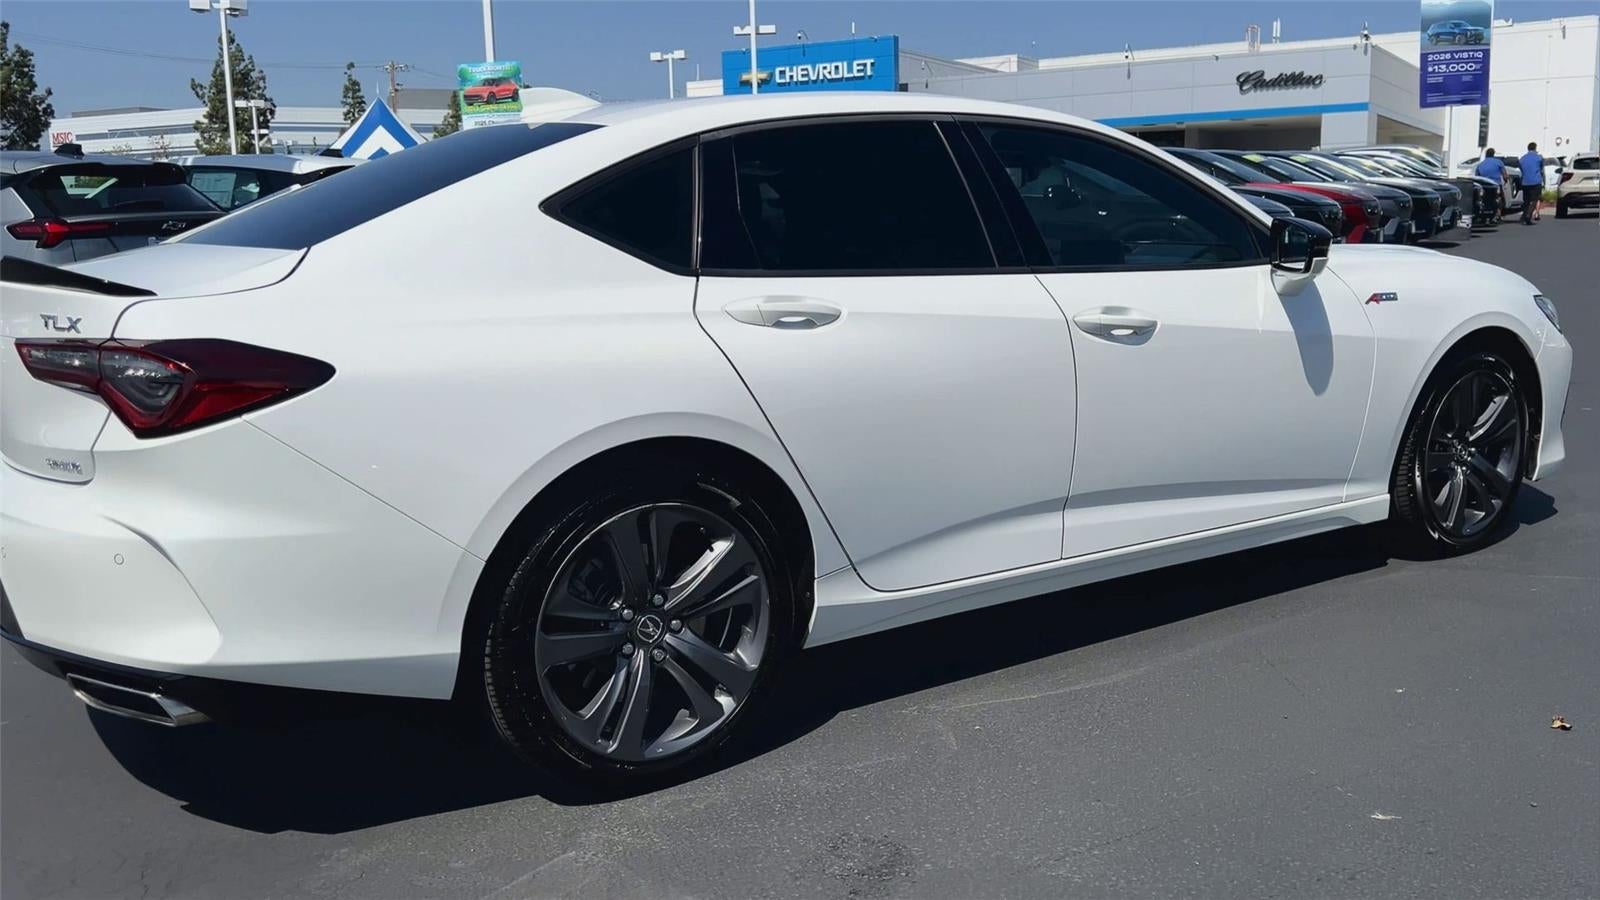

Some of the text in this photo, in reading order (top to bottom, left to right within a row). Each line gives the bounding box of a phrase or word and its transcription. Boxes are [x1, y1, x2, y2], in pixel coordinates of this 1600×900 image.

[1427, 51, 1484, 61] 2026 VISTIQ
[775, 59, 875, 84] CHEVROLET
[1236, 70, 1323, 94] Cadillac
[40, 313, 82, 334] TLX
